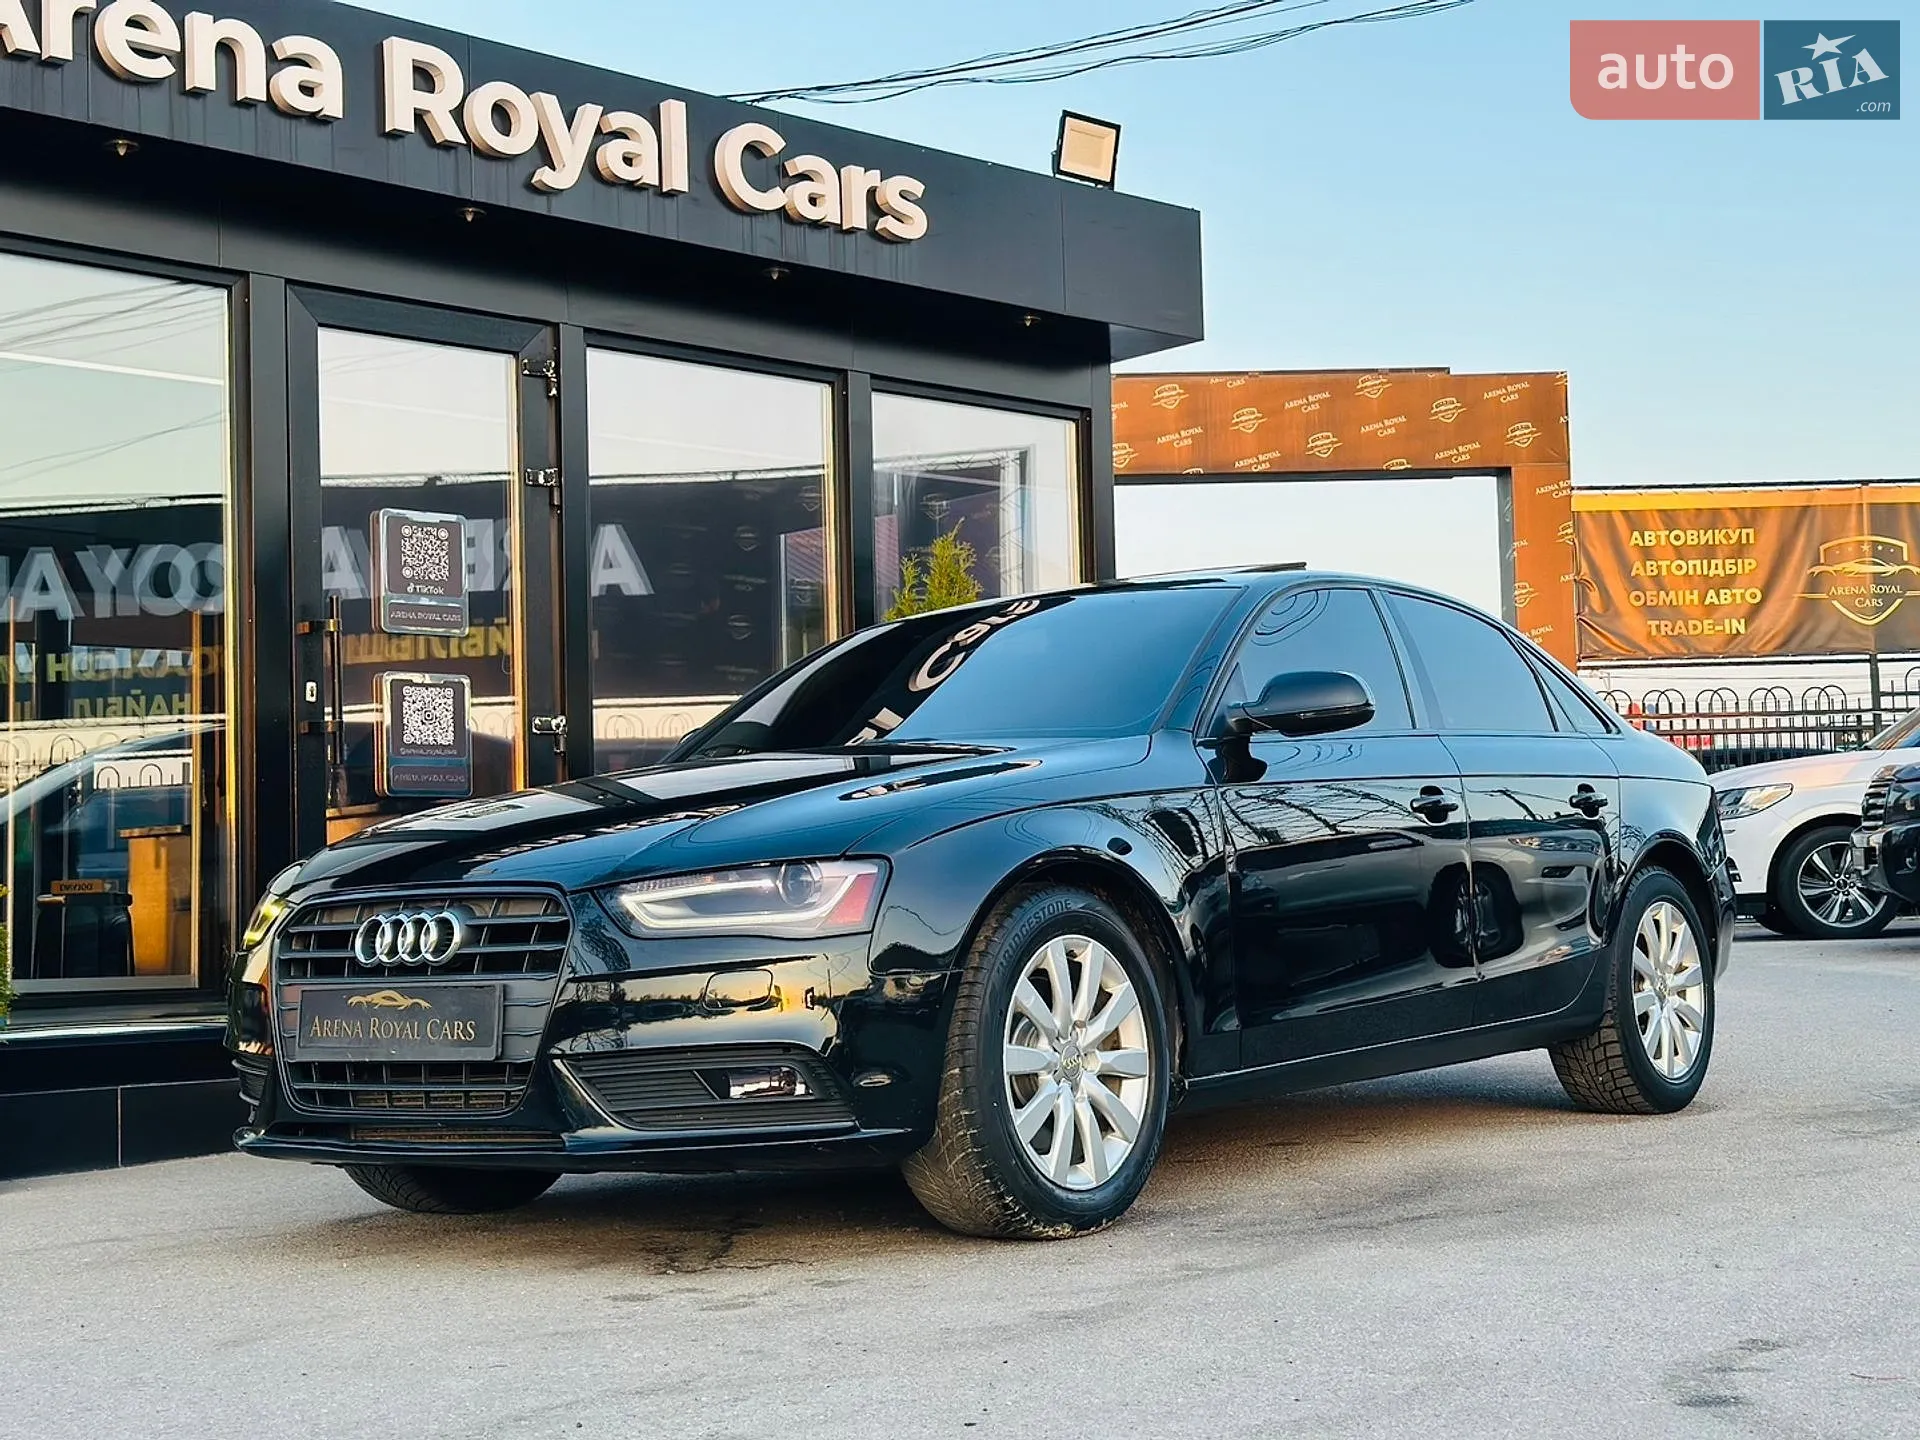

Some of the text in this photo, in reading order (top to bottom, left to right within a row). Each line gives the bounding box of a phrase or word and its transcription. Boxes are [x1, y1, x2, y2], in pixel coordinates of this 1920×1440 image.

[381, 35, 689, 195] Royal
[713, 121, 929, 241] Cars
[1629, 528, 1755, 548] АВТОВИКУП
[1631, 558, 1758, 578] АВТОПІДБІР
[1628, 587, 1763, 607] ОБМІН АВТО
[1829, 583, 1904, 596] ARENA ROYAL
[1854, 597, 1883, 608] CARS
[1647, 619, 1747, 637] TRADE-IN
[309, 1015, 476, 1041] ARENA ROYAL CARS
